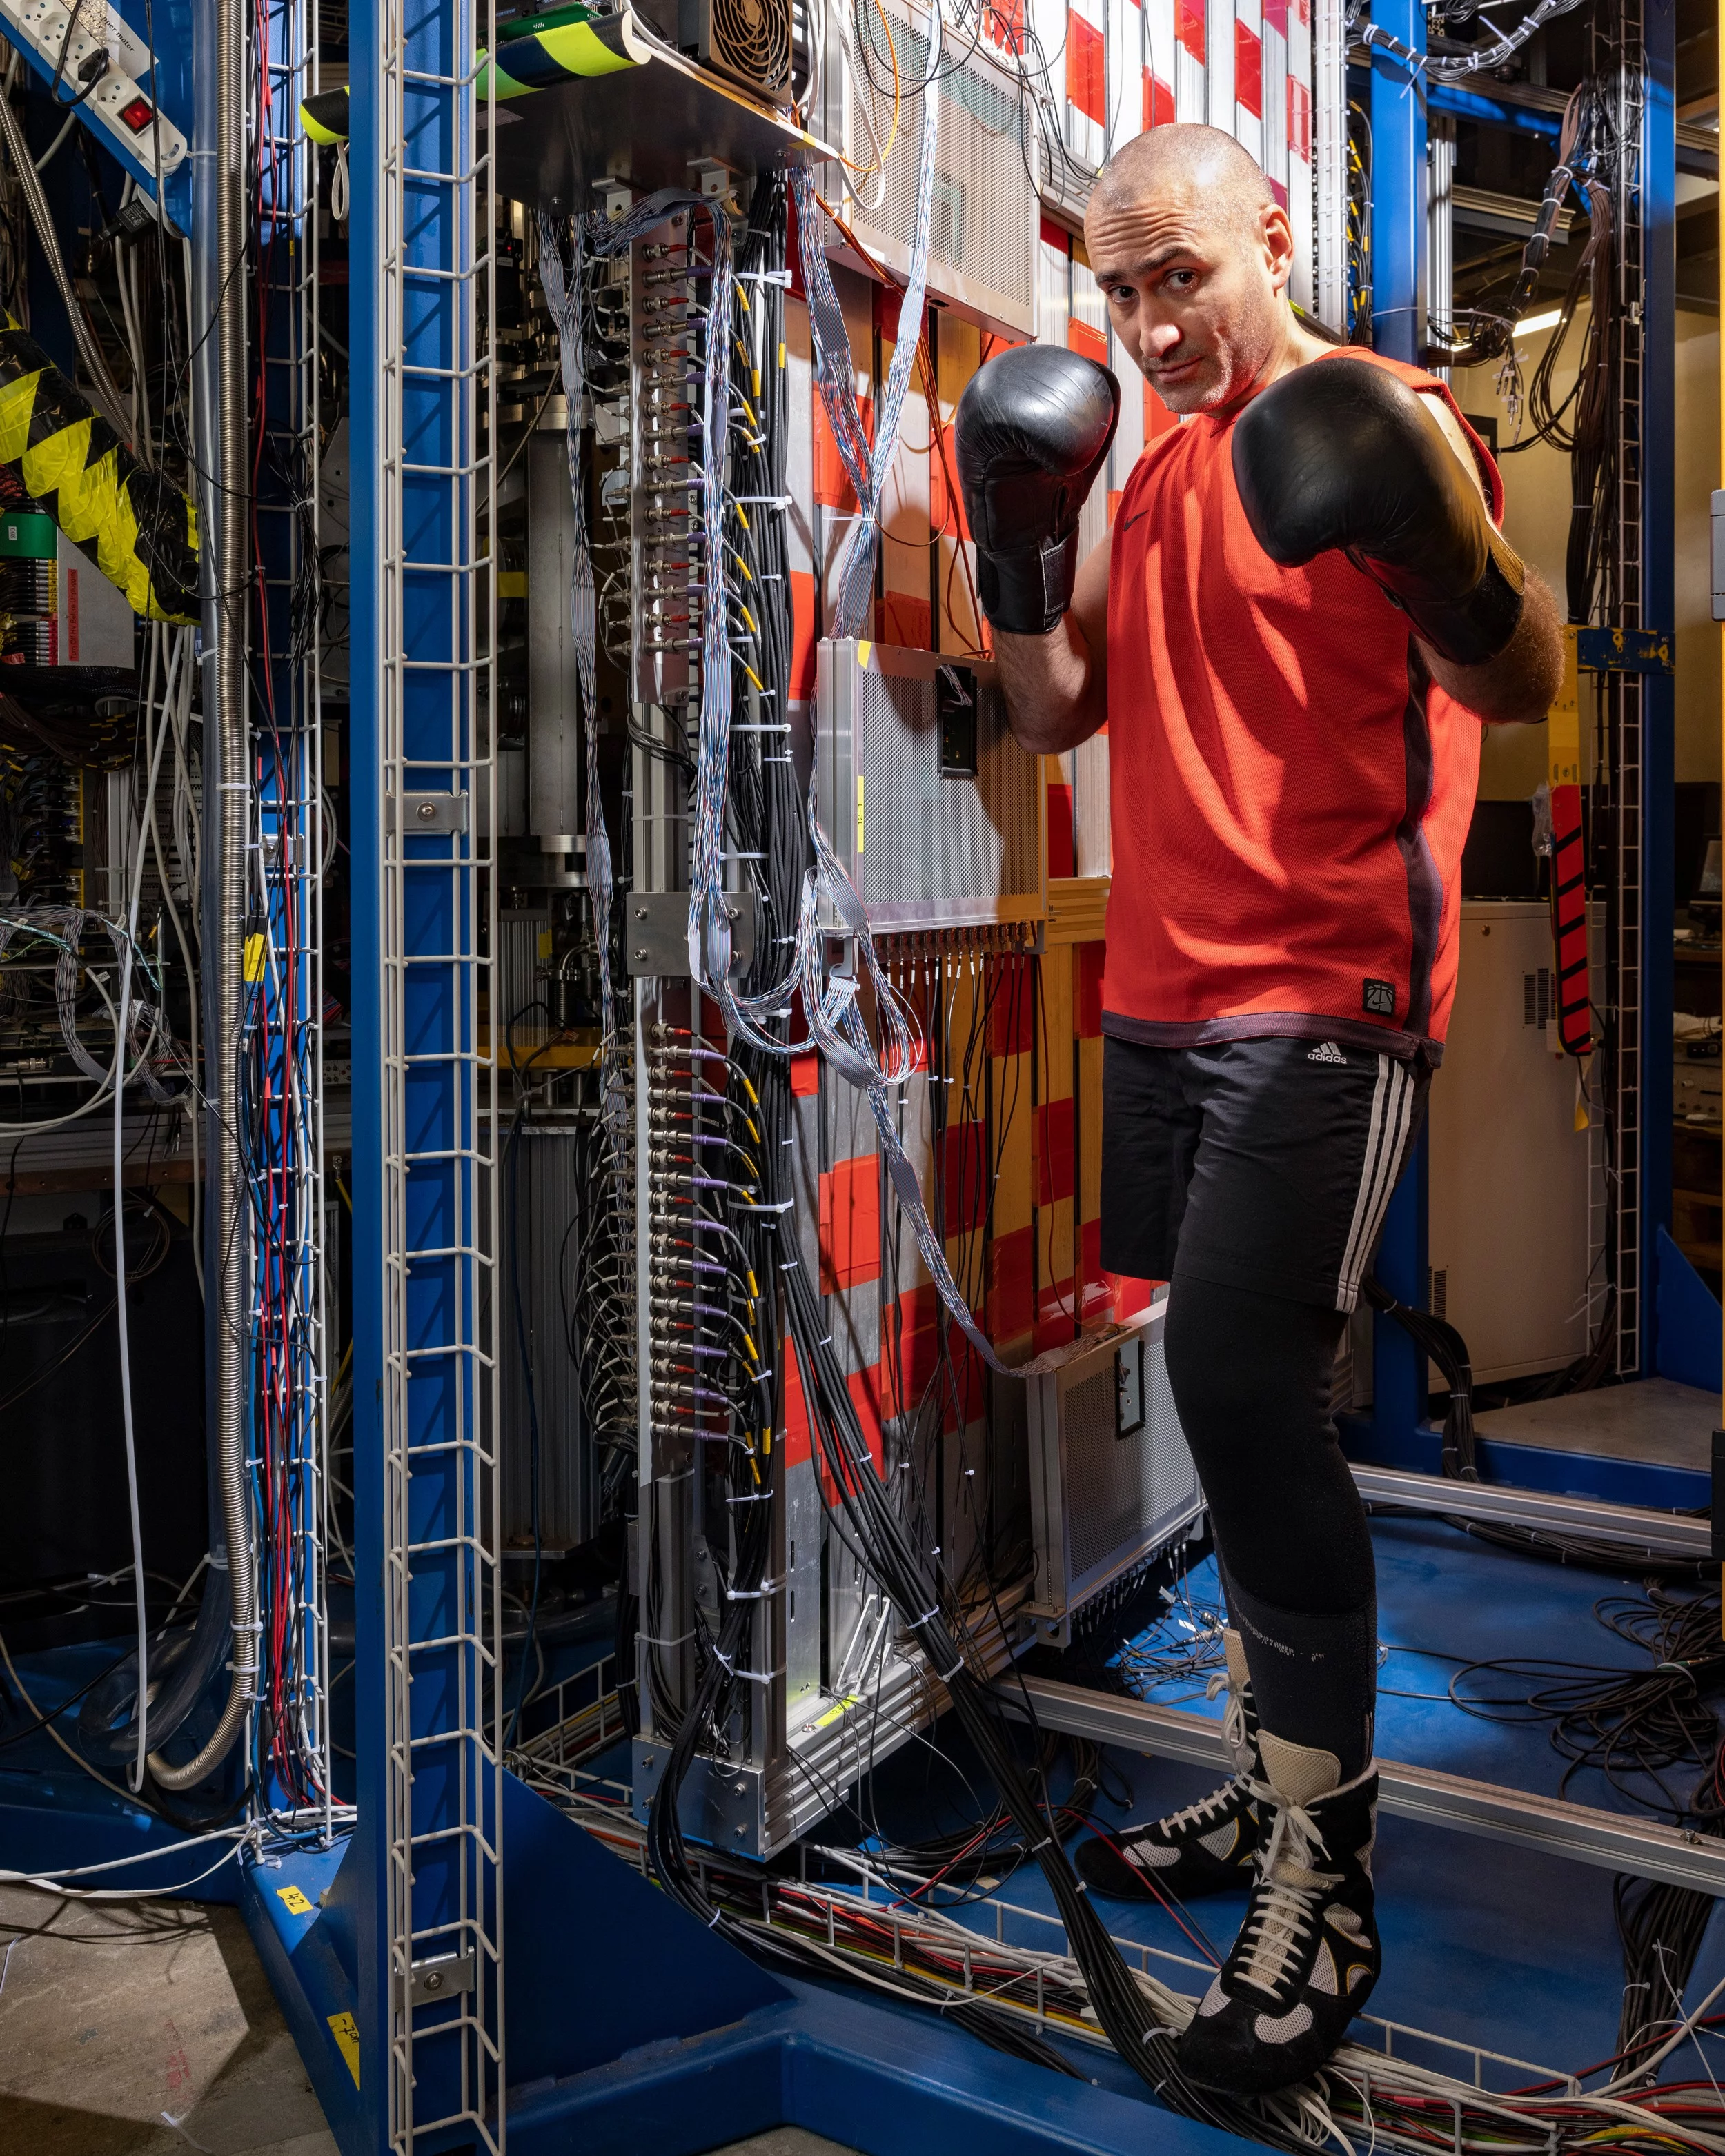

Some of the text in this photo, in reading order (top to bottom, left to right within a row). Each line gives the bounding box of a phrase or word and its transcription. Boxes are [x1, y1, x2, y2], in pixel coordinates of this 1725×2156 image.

[116, 32, 135, 52] motor
[70, 625, 76, 634] HV
[1307, 1052, 1348, 1065] adidas
